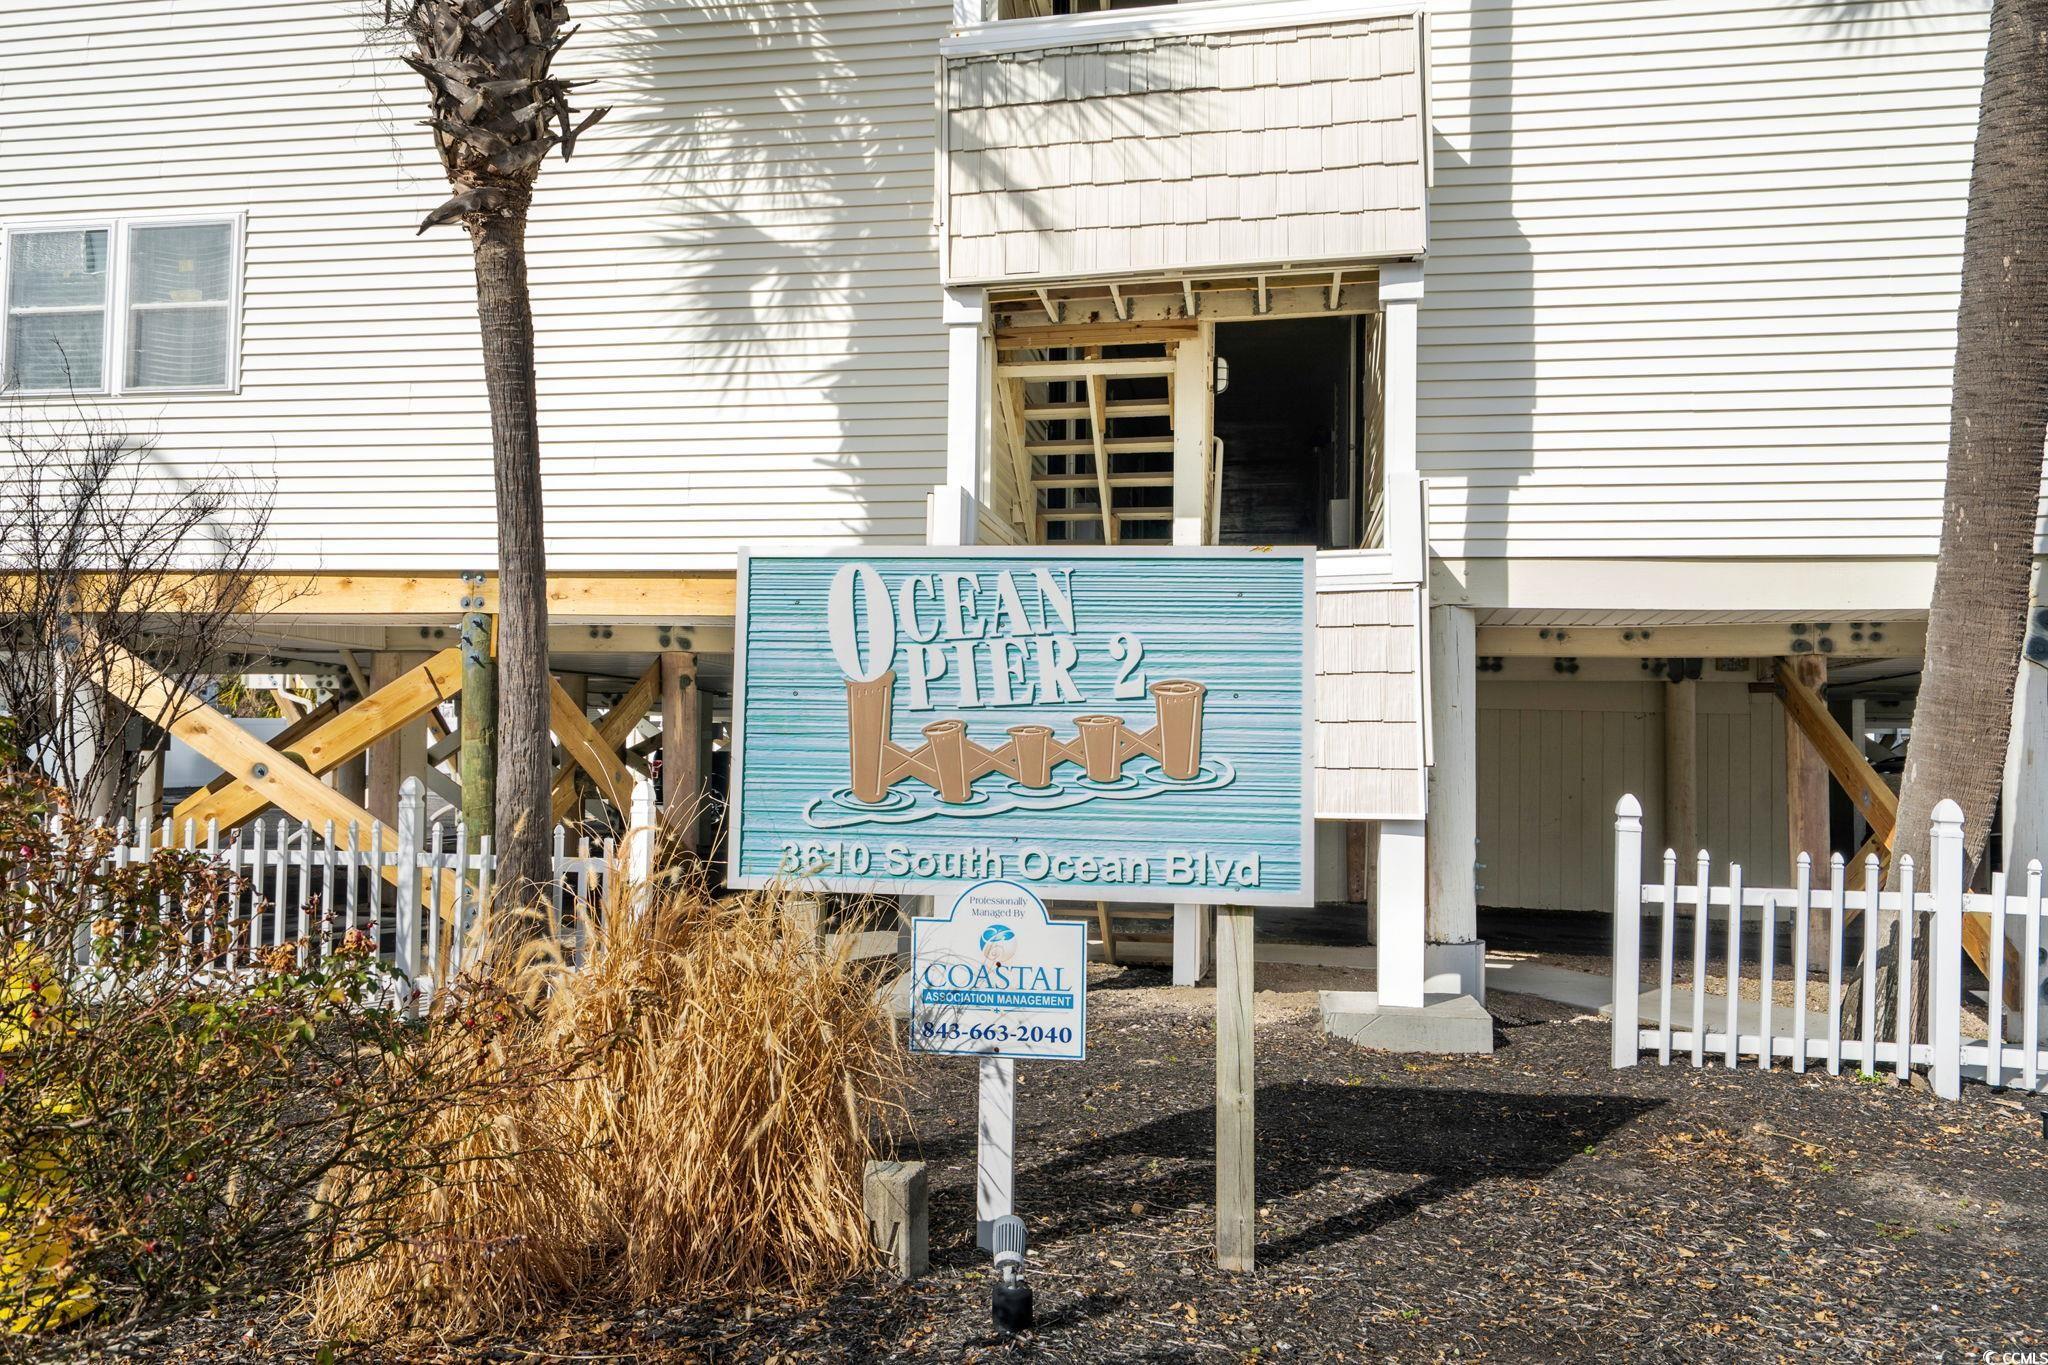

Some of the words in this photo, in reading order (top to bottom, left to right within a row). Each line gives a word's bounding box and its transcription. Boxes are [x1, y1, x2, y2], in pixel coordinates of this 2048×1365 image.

[828, 562, 1077, 683] OCEAN
[904, 633, 1087, 712] PIER
[1110, 632, 1148, 700] 2
[783, 840, 872, 875] 3610
[884, 843, 1005, 879] South
[1018, 846, 1151, 884] Ocean
[1166, 850, 1261, 887] Blvd
[969, 896, 1028, 906] Professionally
[971, 908, 1011, 918] Managed
[1013, 909, 1026, 919] By
[924, 963, 1073, 992] COASTAL
[925, 991, 995, 1004] ASSOCIATION
[998, 995, 1072, 1006] MANAGEMENT
[922, 1021, 1073, 1044] 843-663-2040
